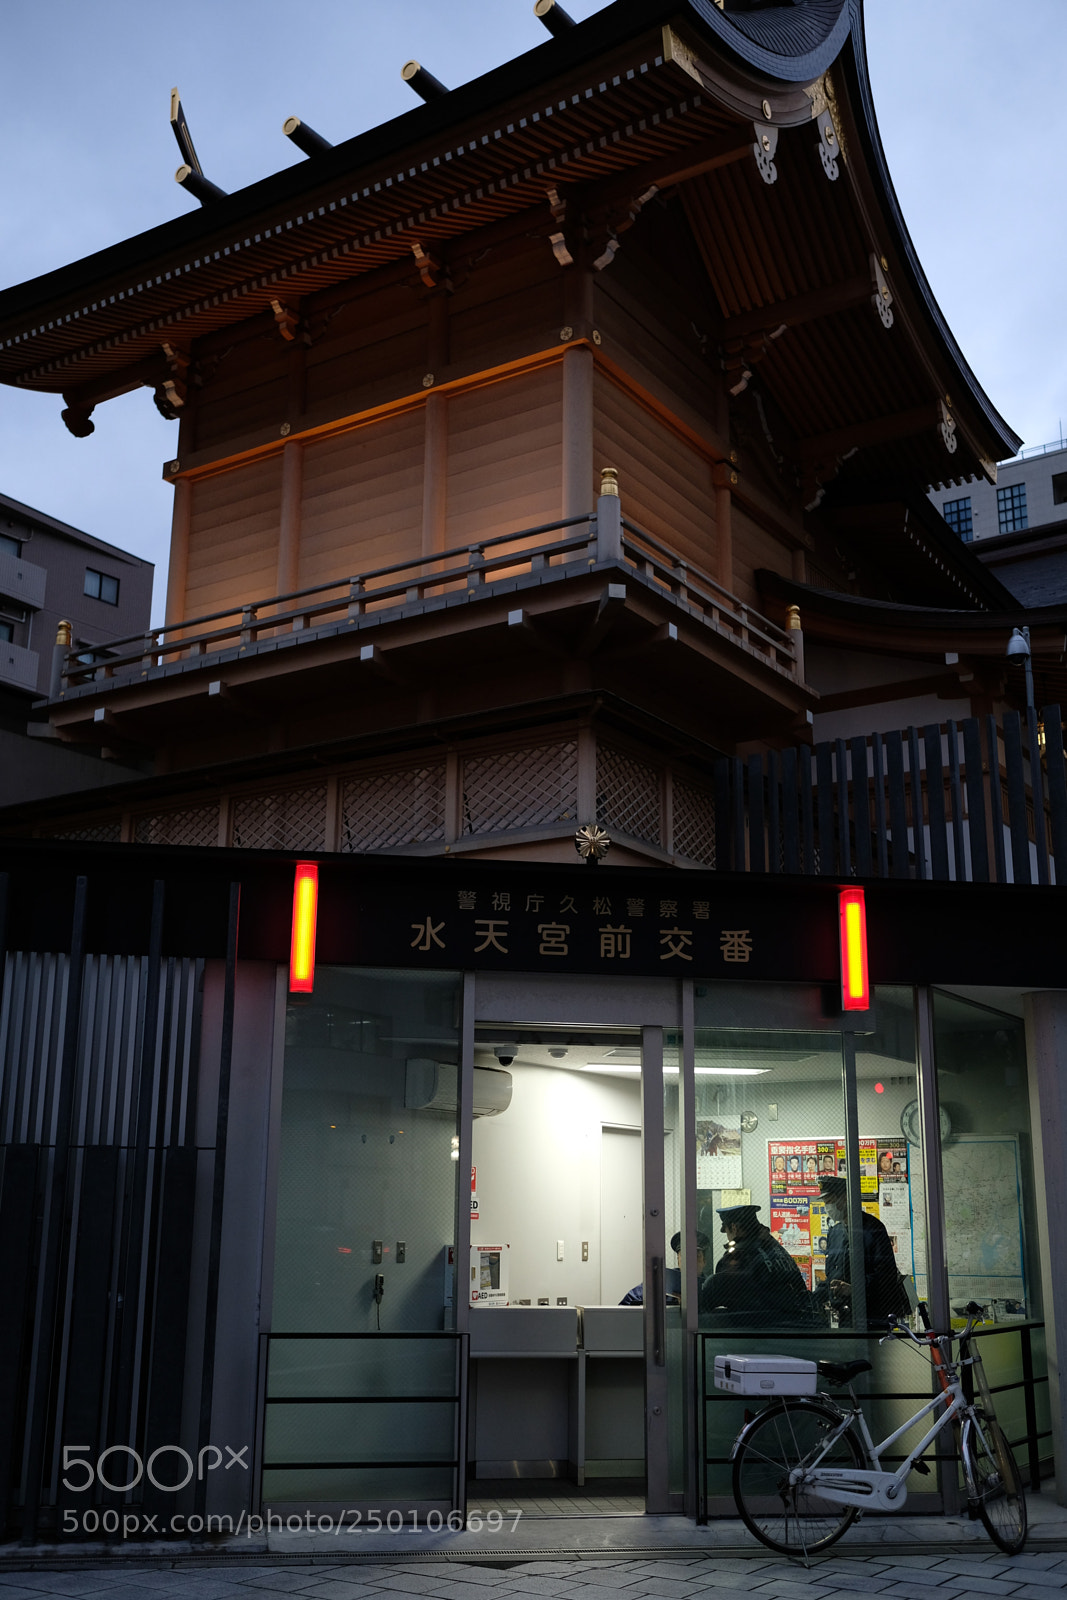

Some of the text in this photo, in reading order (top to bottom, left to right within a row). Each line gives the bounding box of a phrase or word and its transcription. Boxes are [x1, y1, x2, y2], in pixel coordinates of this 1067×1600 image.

[457, 890, 711, 920] 警視庁久松警察署
[410, 916, 753, 963] 水天宮前交番
